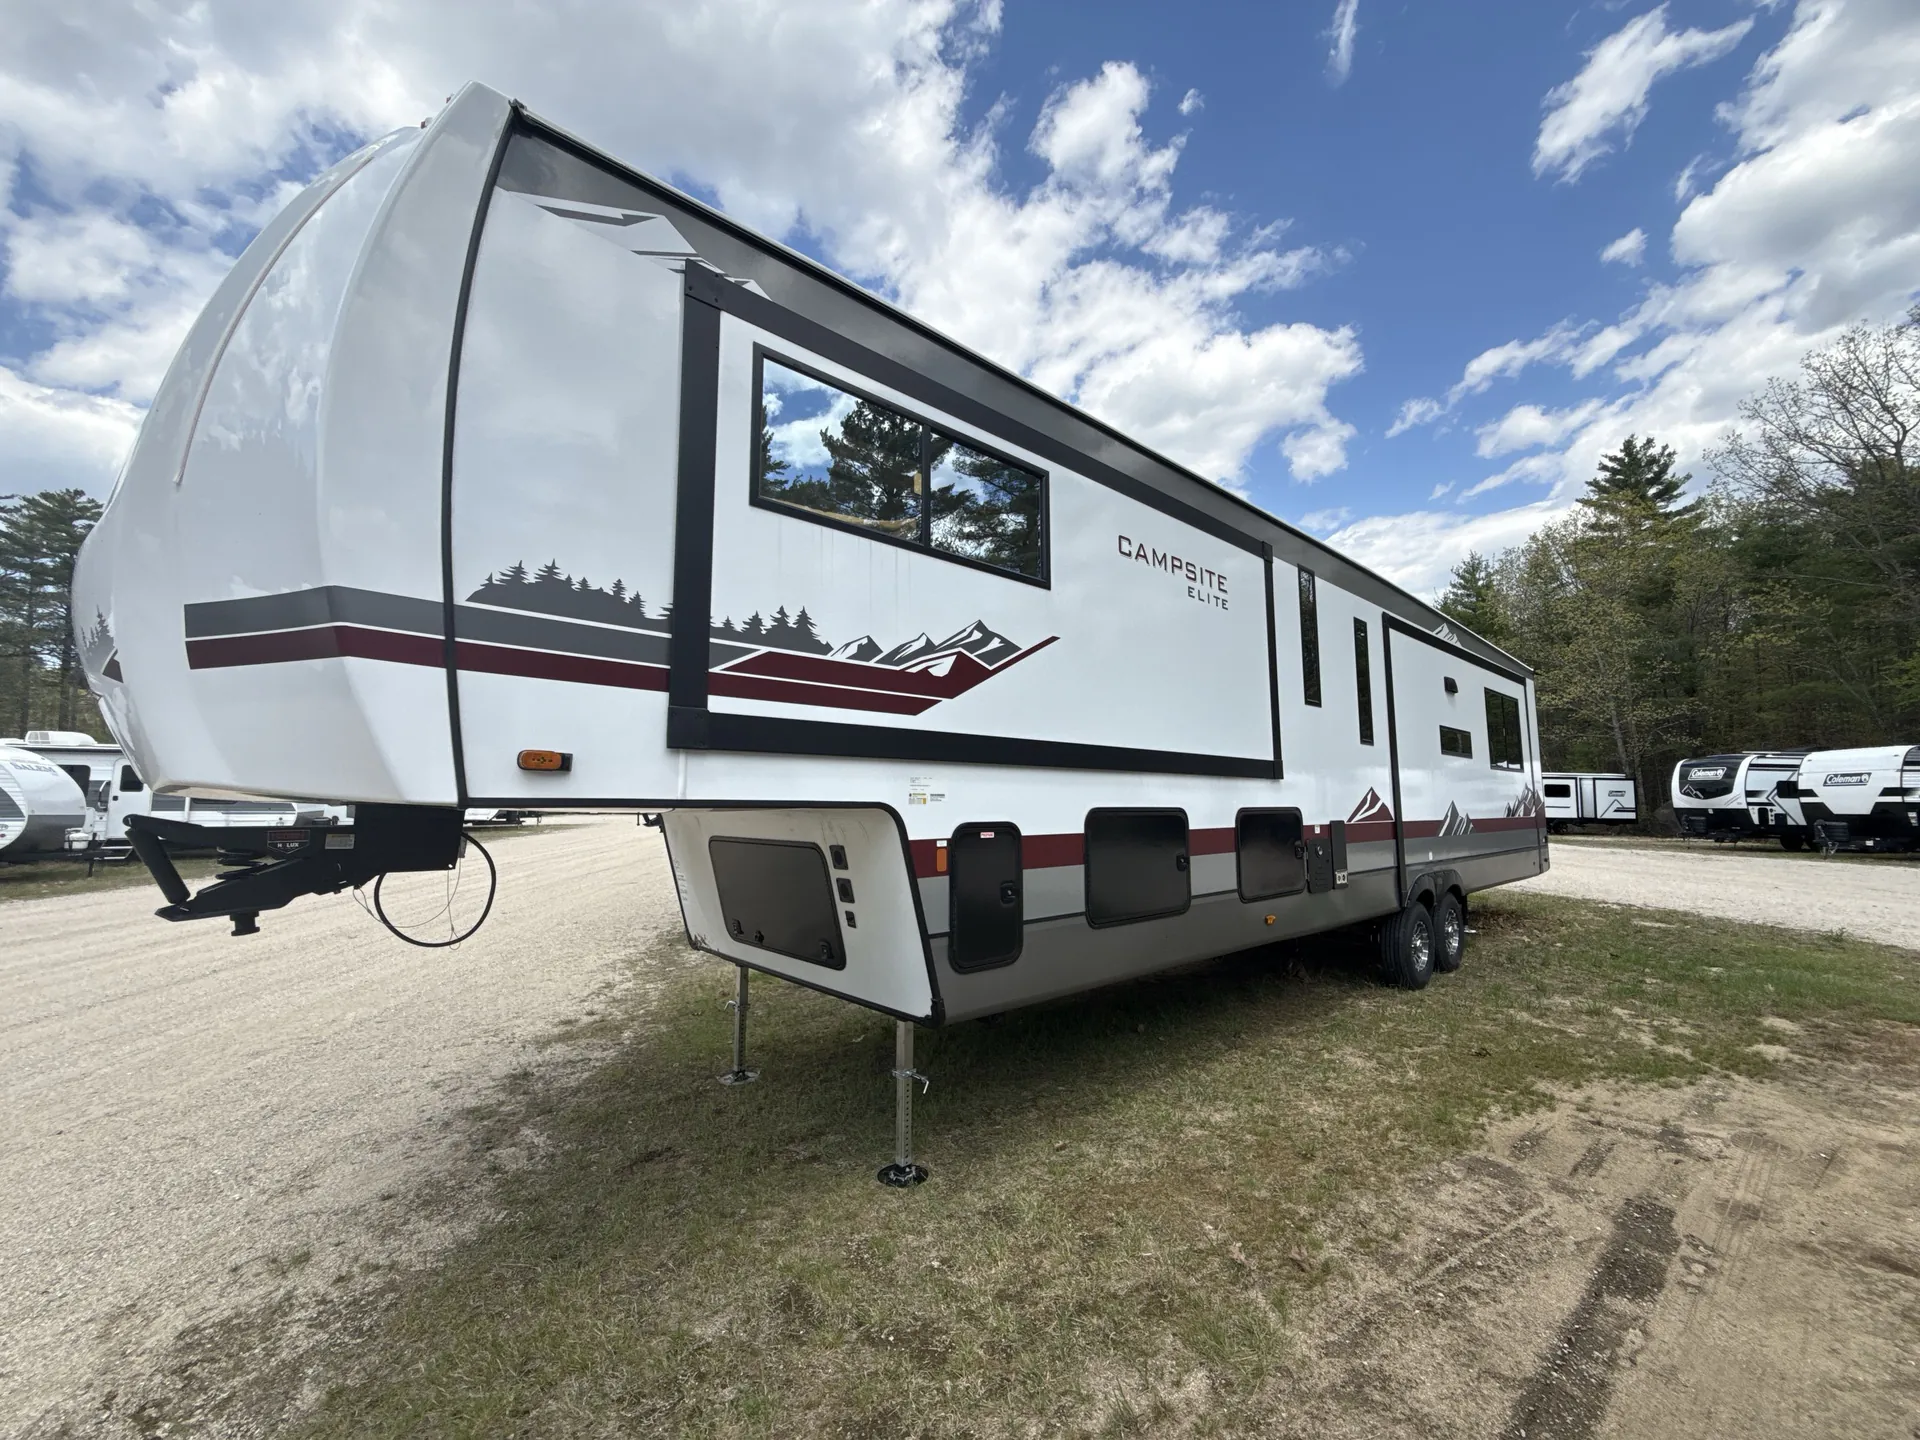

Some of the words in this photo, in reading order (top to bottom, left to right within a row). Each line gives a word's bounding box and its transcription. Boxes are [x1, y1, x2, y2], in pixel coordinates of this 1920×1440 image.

[1118, 535, 1228, 594] CAMPSITE
[1188, 586, 1229, 611] ELITE
[1691, 769, 1717, 778] Coleman
[1826, 774, 1861, 784] Coleman
